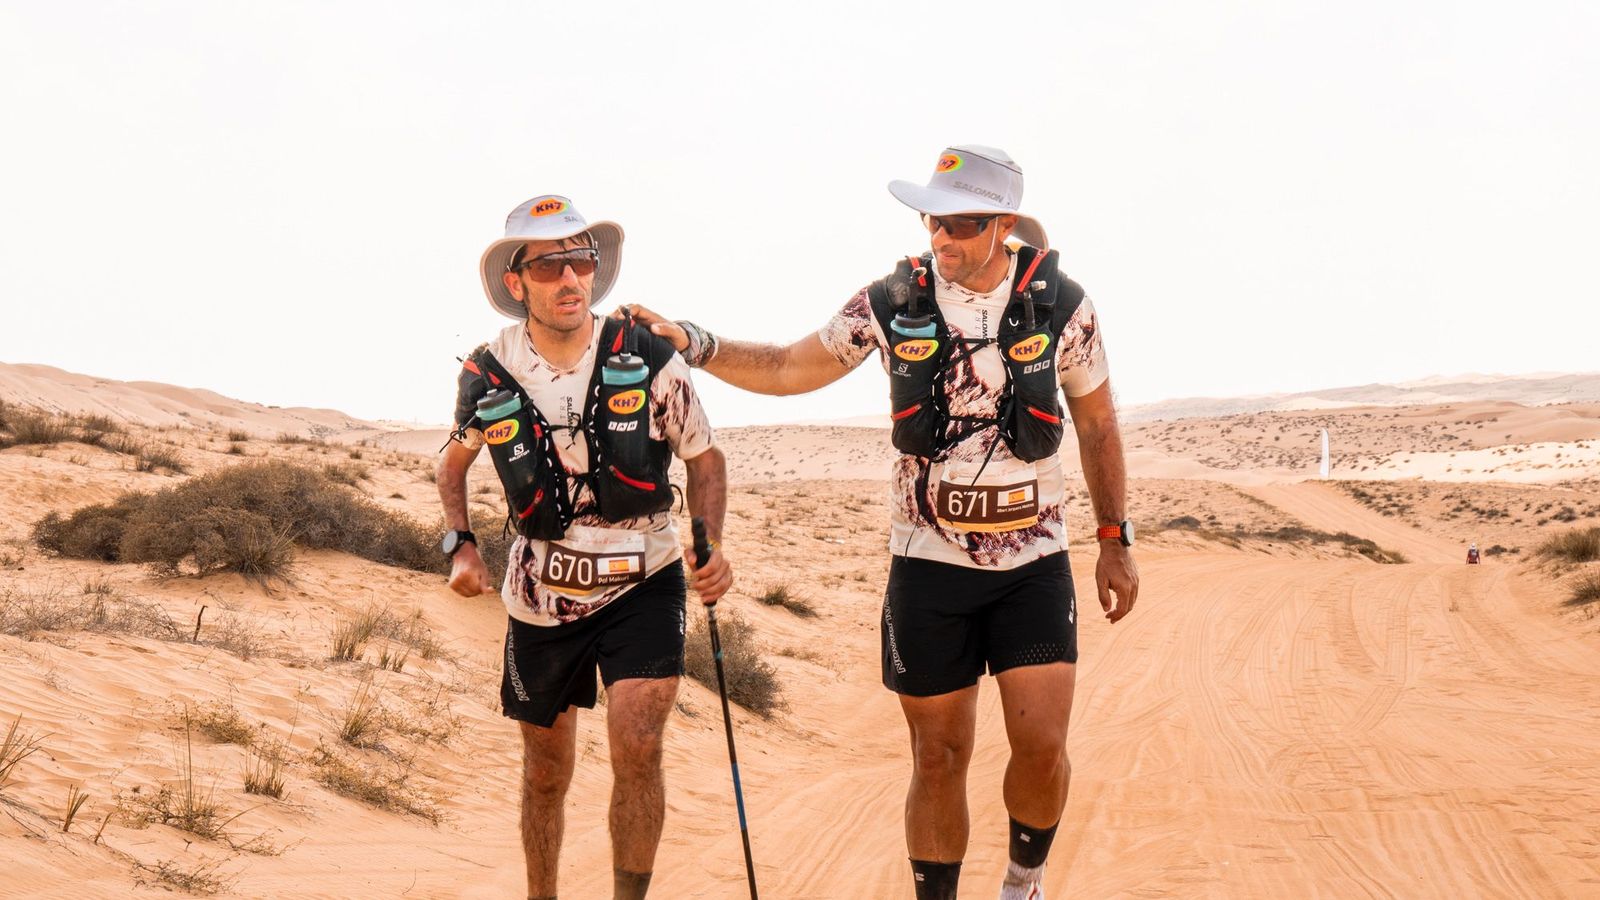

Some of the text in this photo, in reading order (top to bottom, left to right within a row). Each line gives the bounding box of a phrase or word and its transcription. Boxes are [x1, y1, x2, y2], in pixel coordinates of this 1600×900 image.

[953, 181, 1004, 203] SALOMON
[566, 396, 574, 437] SALOM
[948, 490, 988, 518] 671
[549, 552, 593, 586] 670
